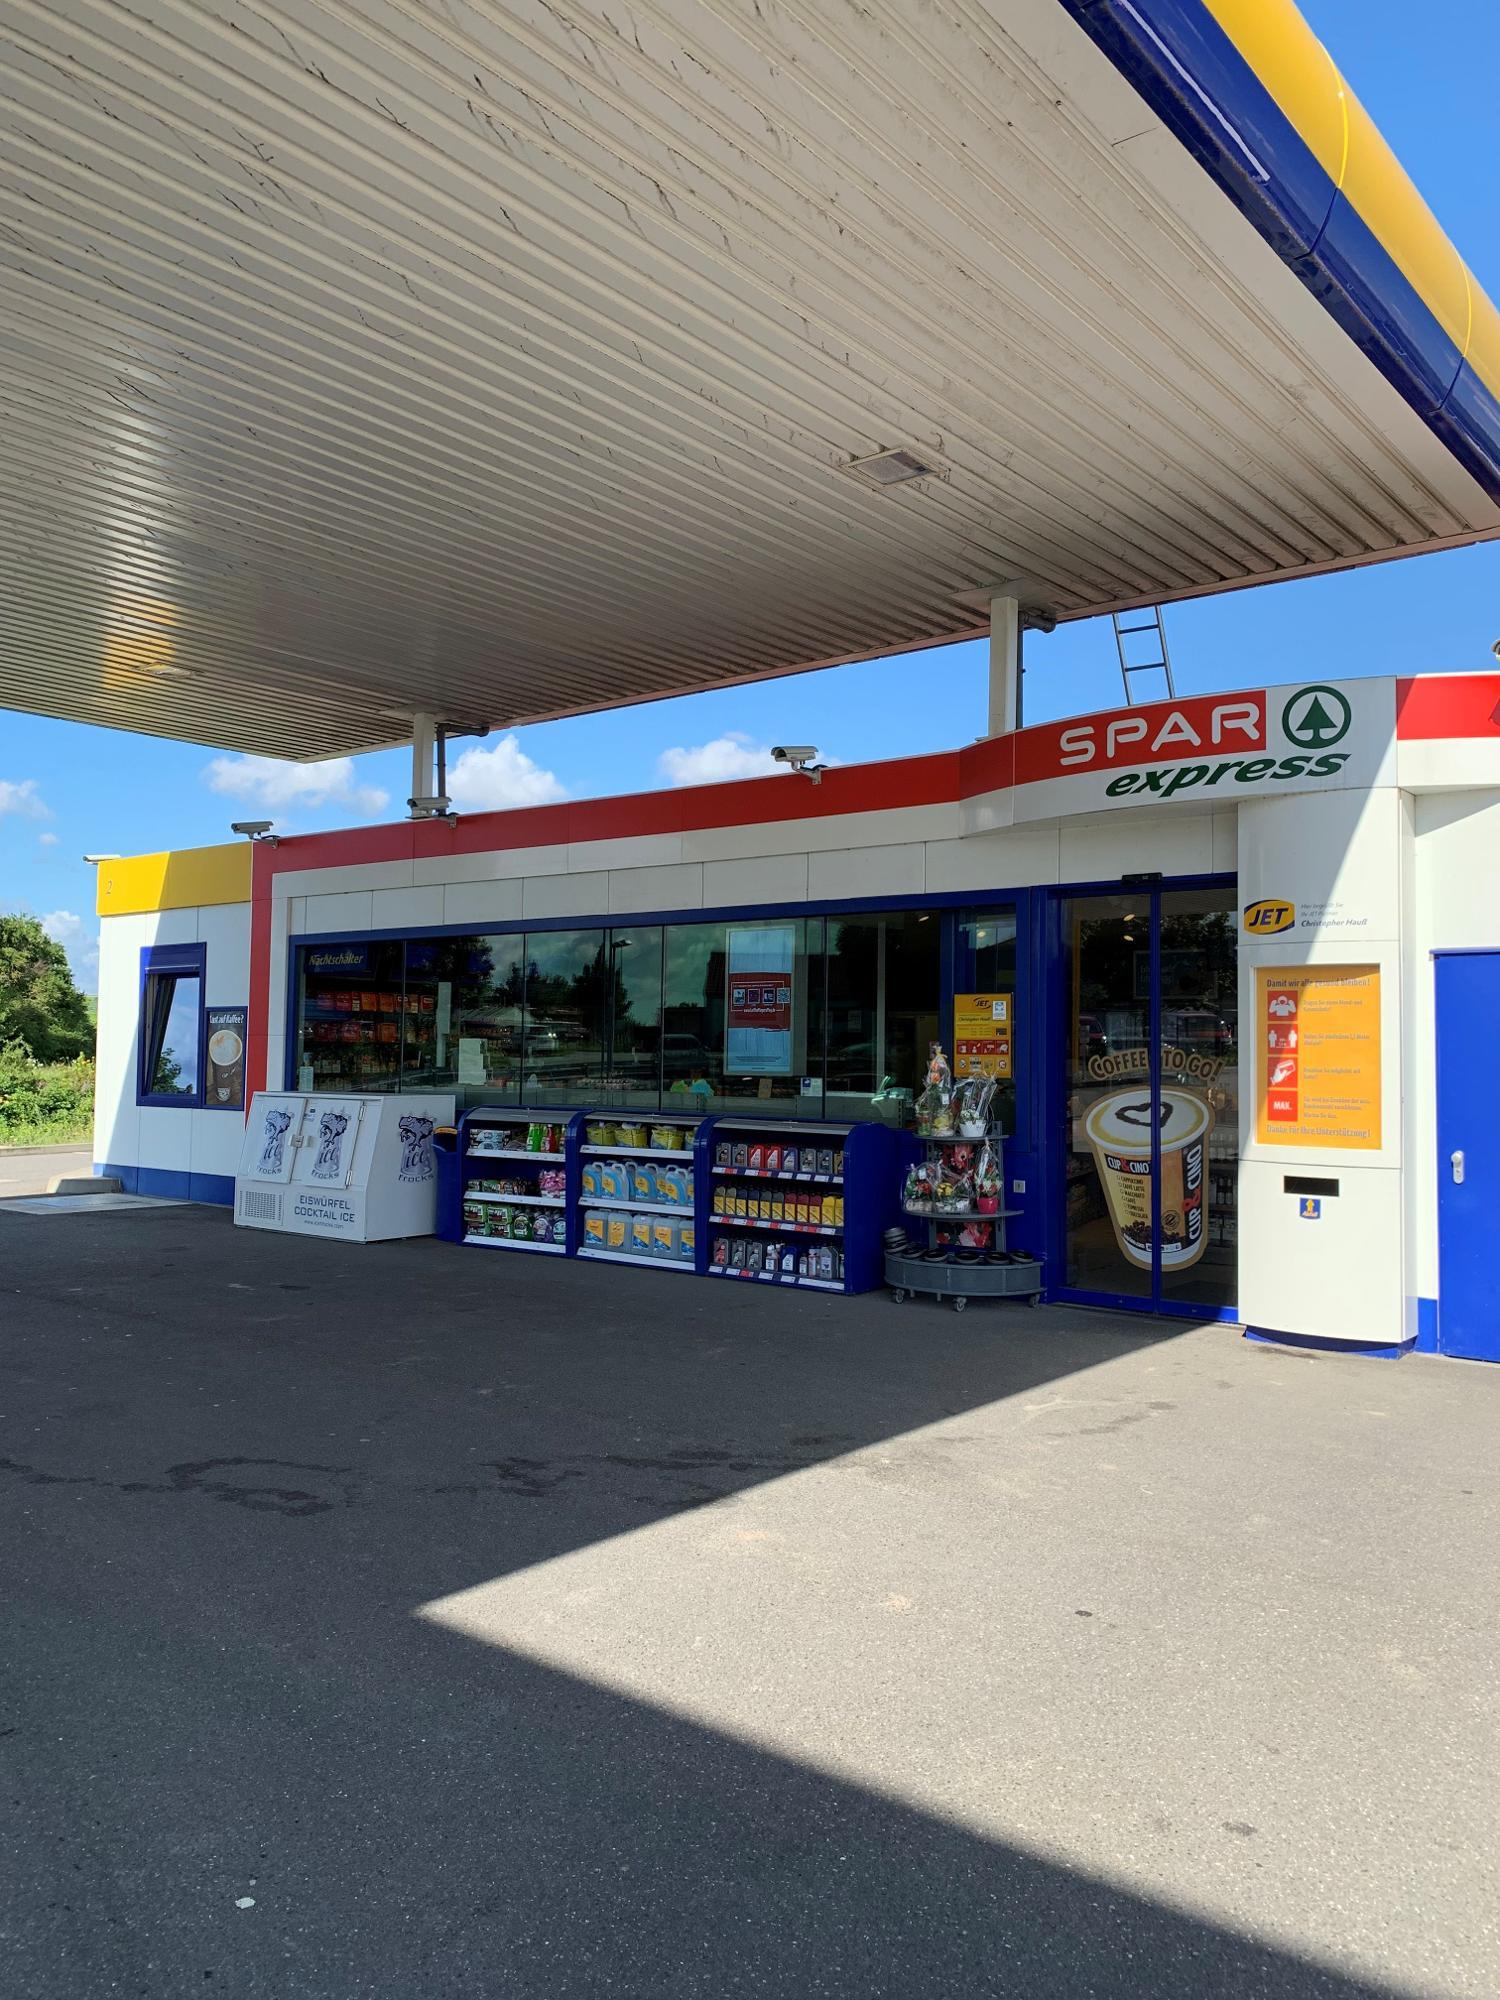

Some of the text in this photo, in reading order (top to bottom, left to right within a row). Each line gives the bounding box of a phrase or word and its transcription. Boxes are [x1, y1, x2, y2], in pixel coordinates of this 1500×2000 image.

[1060, 702, 1260, 766] SPAR
[1105, 753, 1352, 797] express
[1248, 907, 1290, 927] JET
[1301, 918, 1345, 929] Christopher
[308, 952, 364, 966] Nachtschalter
[1266, 979, 1288, 988] Damit
[1288, 979, 1300, 988] wir
[1300, 979, 1314, 987] alle
[226, 1014, 244, 1024] Kaffee?
[1090, 1050, 1224, 1082] COFFEE TO GO!
[1273, 1101, 1293, 1110] MAX.
[1266, 1124, 1287, 1133] Danke
[1107, 1157, 1150, 1174] CUP & CINO
[1183, 1144, 1202, 1240] CUP & CINO
[299, 1195, 351, 1210] EISWÜRFEL
[294, 1206, 355, 1223] COCKTAIL ICE
